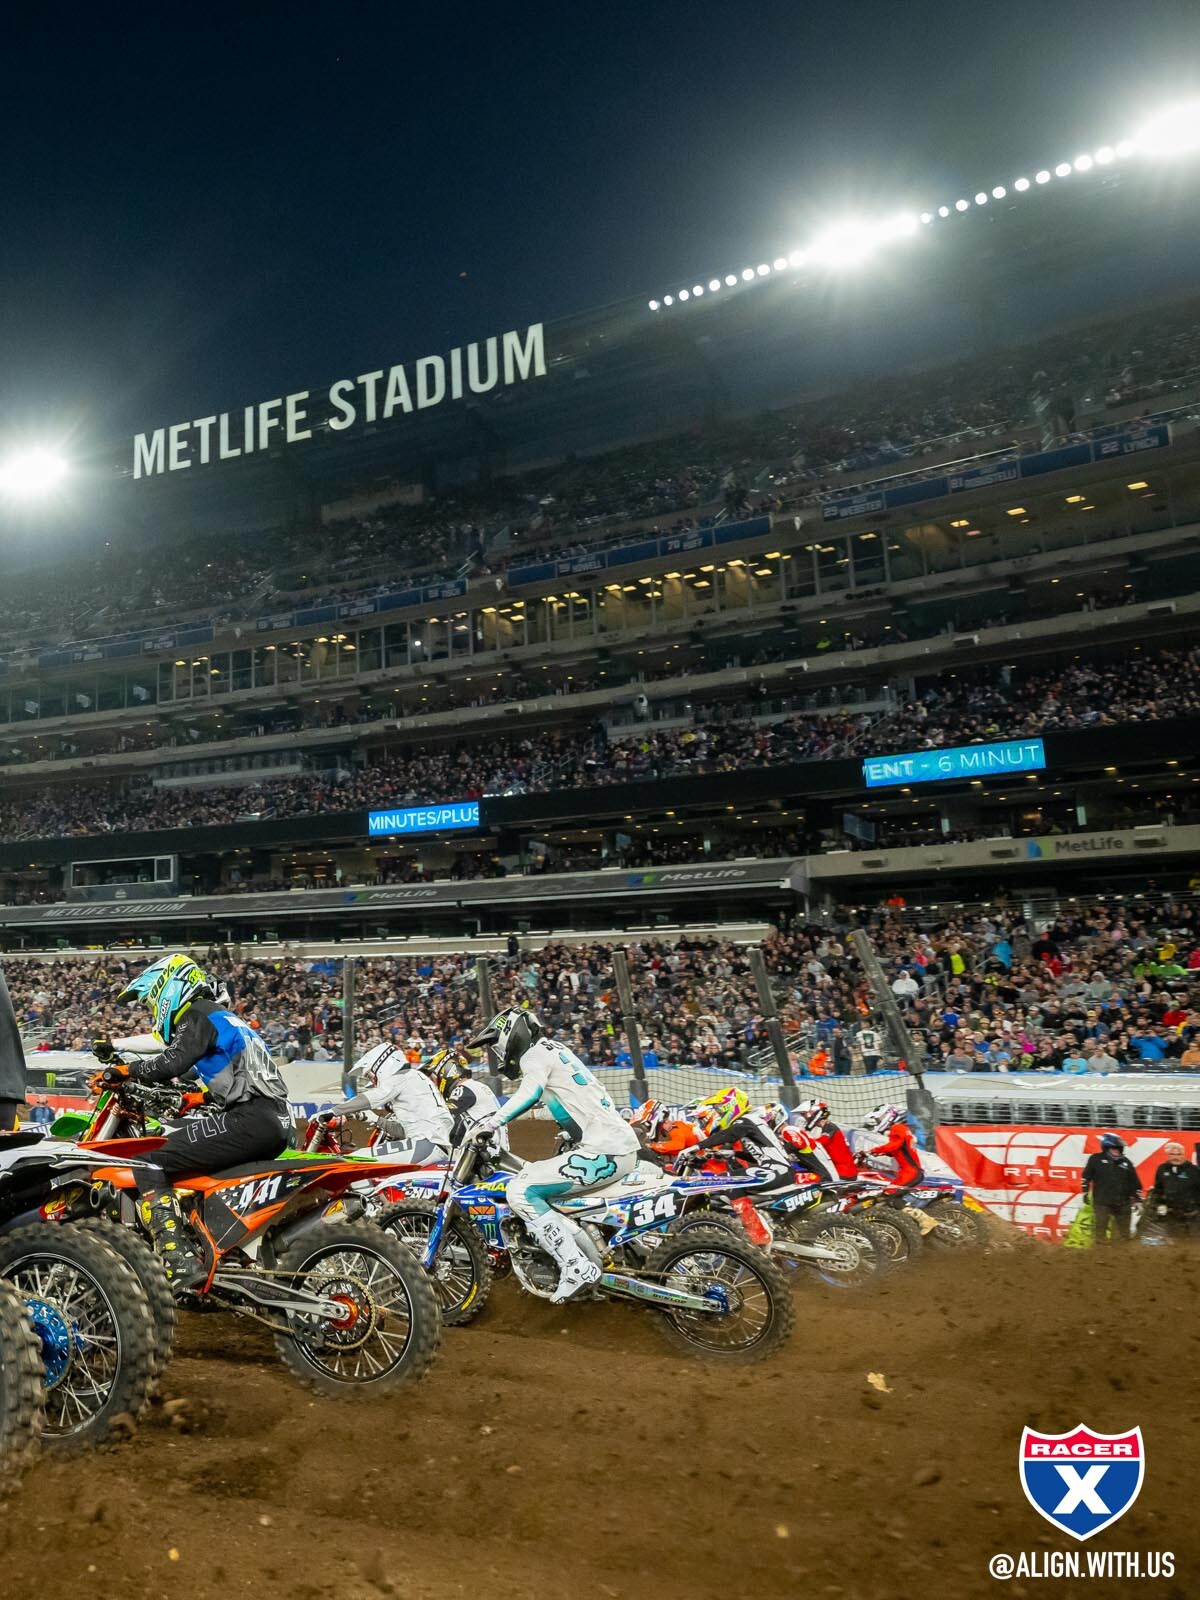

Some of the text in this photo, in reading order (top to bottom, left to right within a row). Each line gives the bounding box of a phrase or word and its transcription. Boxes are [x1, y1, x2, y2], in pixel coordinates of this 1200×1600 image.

[133, 323, 548, 479] METLIFE STADIUM
[938, 755, 952, 773] 6
[1055, 836, 1124, 854] MetLife
[658, 867, 747, 883] MetLife
[368, 889, 438, 901] MetLife
[42, 902, 186, 918] METLIFE STADIUM
[186, 1112, 229, 1143] FLY
[371, 1138, 414, 1157] FLY
[1004, 1167, 1078, 1180] RACI
[238, 1174, 282, 1208] 441
[633, 1192, 677, 1227] 34
[784, 1190, 814, 1223] 944
